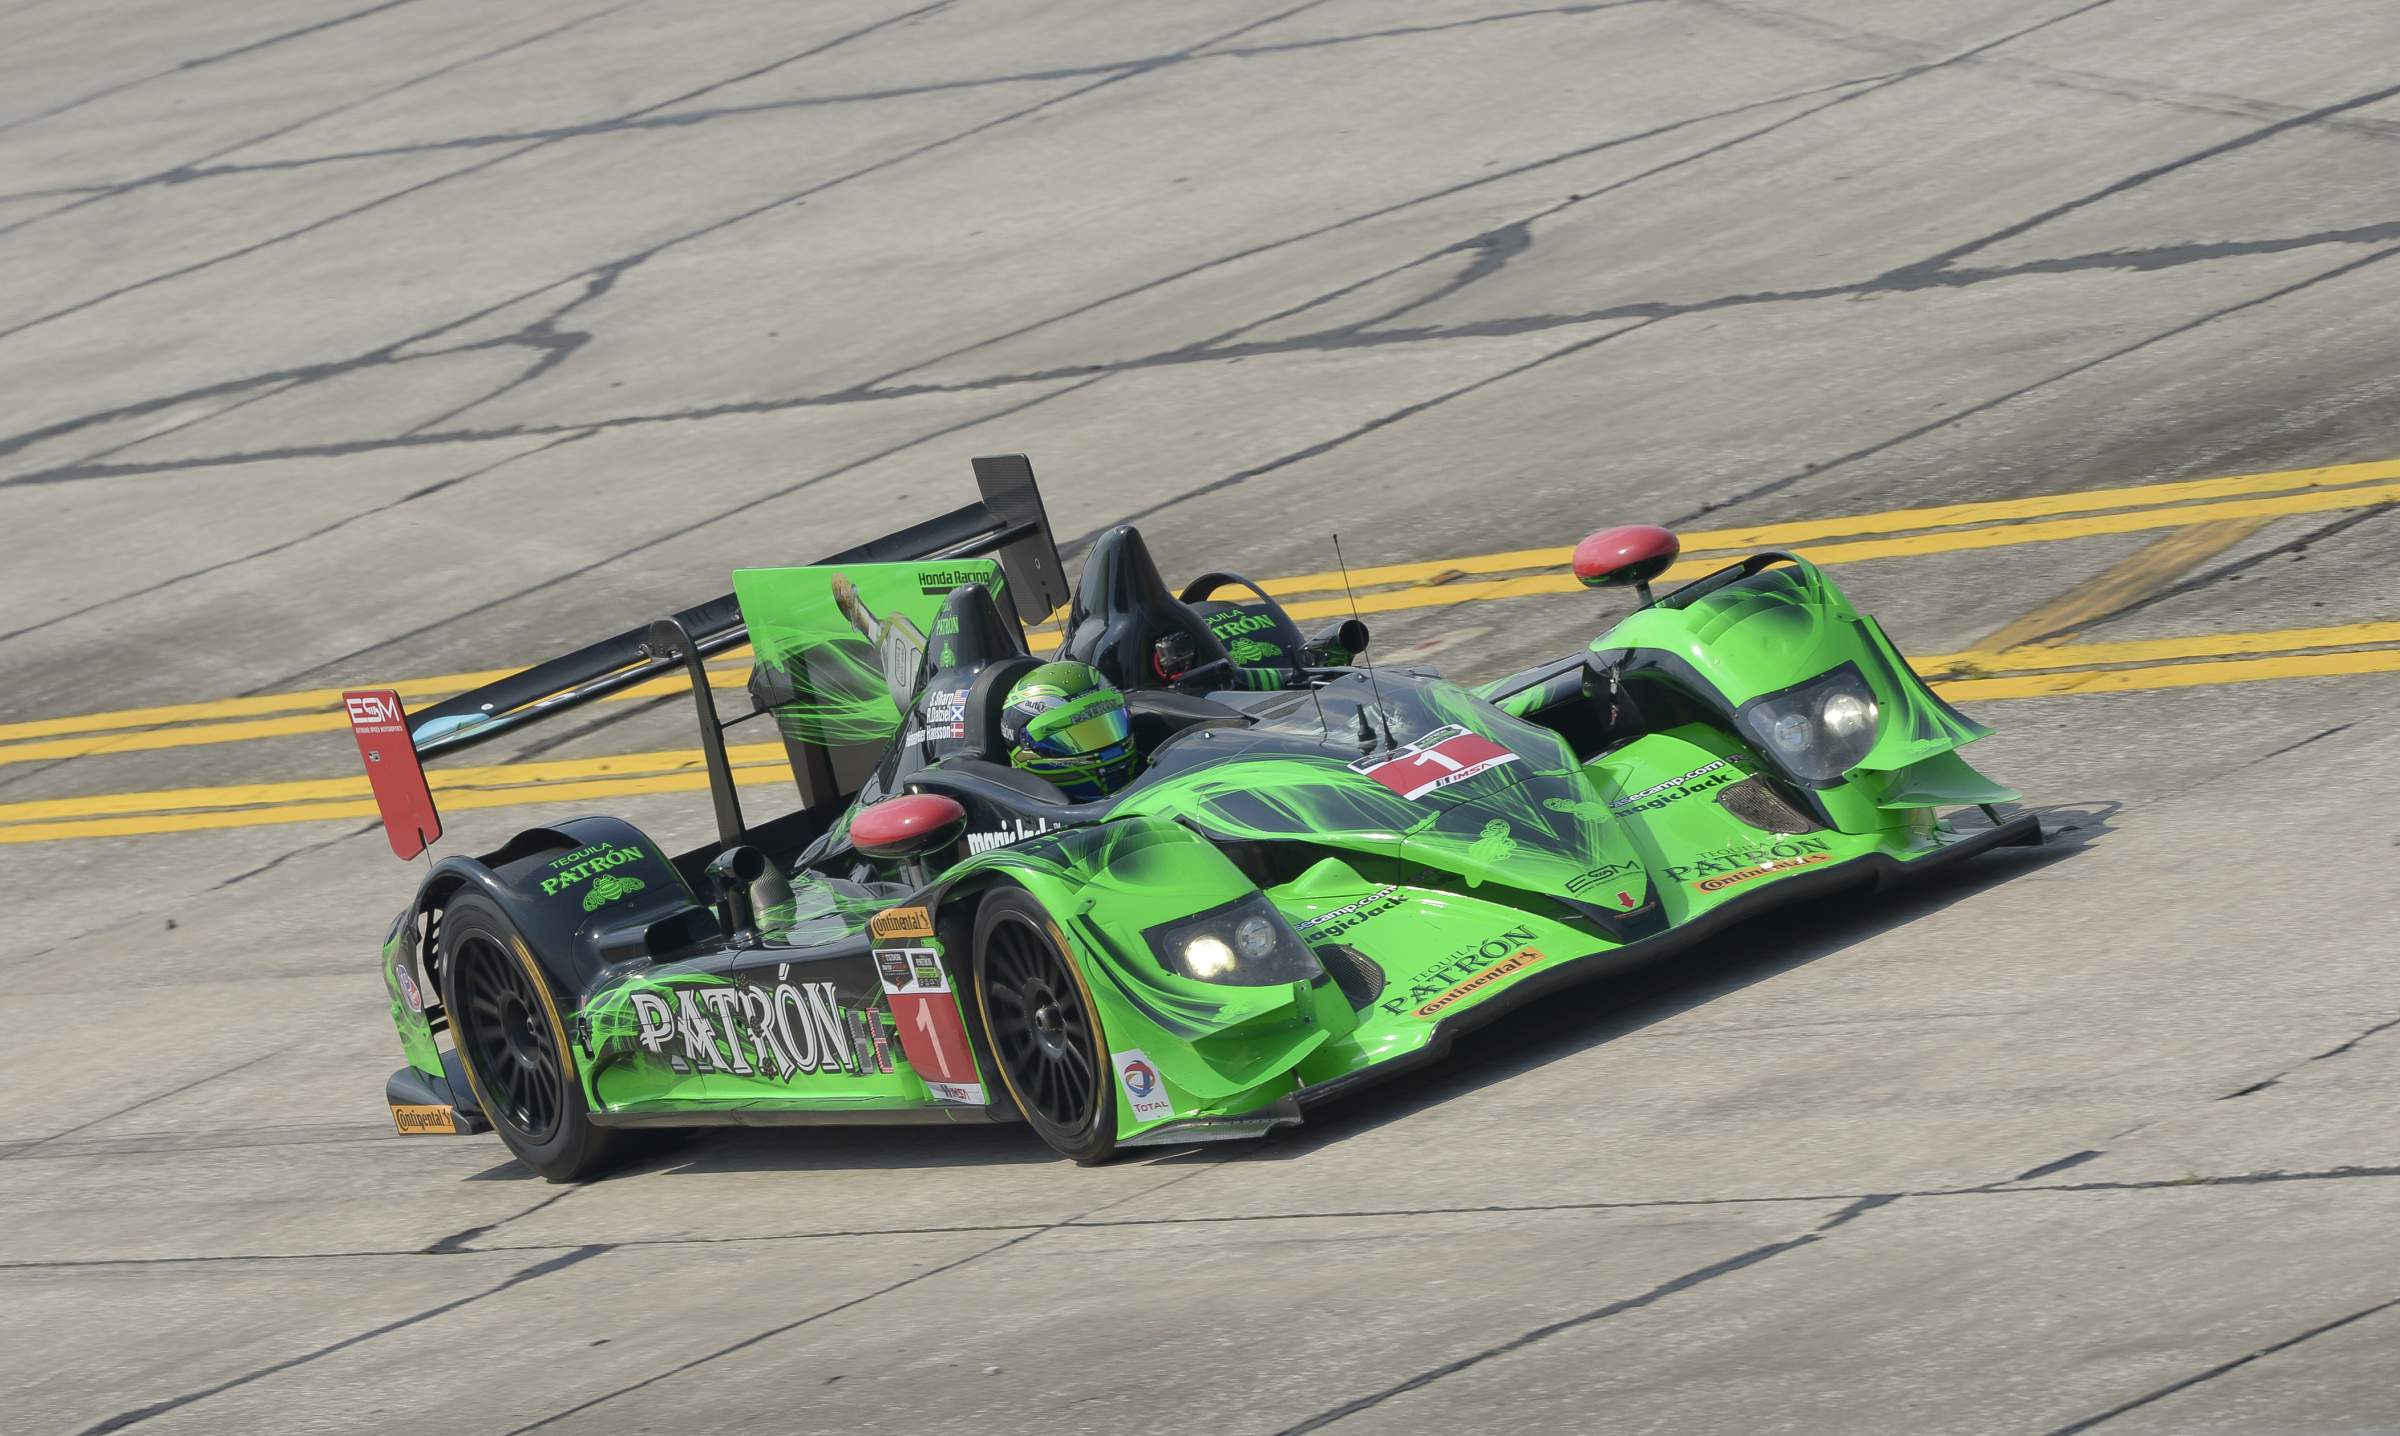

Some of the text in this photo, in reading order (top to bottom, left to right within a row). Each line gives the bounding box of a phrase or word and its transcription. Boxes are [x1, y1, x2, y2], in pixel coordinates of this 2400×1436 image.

[918, 571, 992, 586] Honda Racing
[346, 697, 400, 724] ESM
[1413, 749, 1465, 772] 1
[540, 847, 645, 896] PATRÓN
[548, 842, 613, 869] TEQUILA
[1564, 860, 1641, 893] ESM
[1700, 857, 1811, 891] Continntl
[872, 912, 921, 937] Continental
[1380, 924, 1539, 1016] PATRÓN
[1408, 943, 1479, 983] TEQUILA
[1418, 958, 1523, 1017] Continental
[630, 963, 854, 1084] PATRÓN
[915, 998, 951, 1079] 1
[396, 1109, 445, 1131] Continental
[1134, 1101, 1169, 1113] TOTAL
